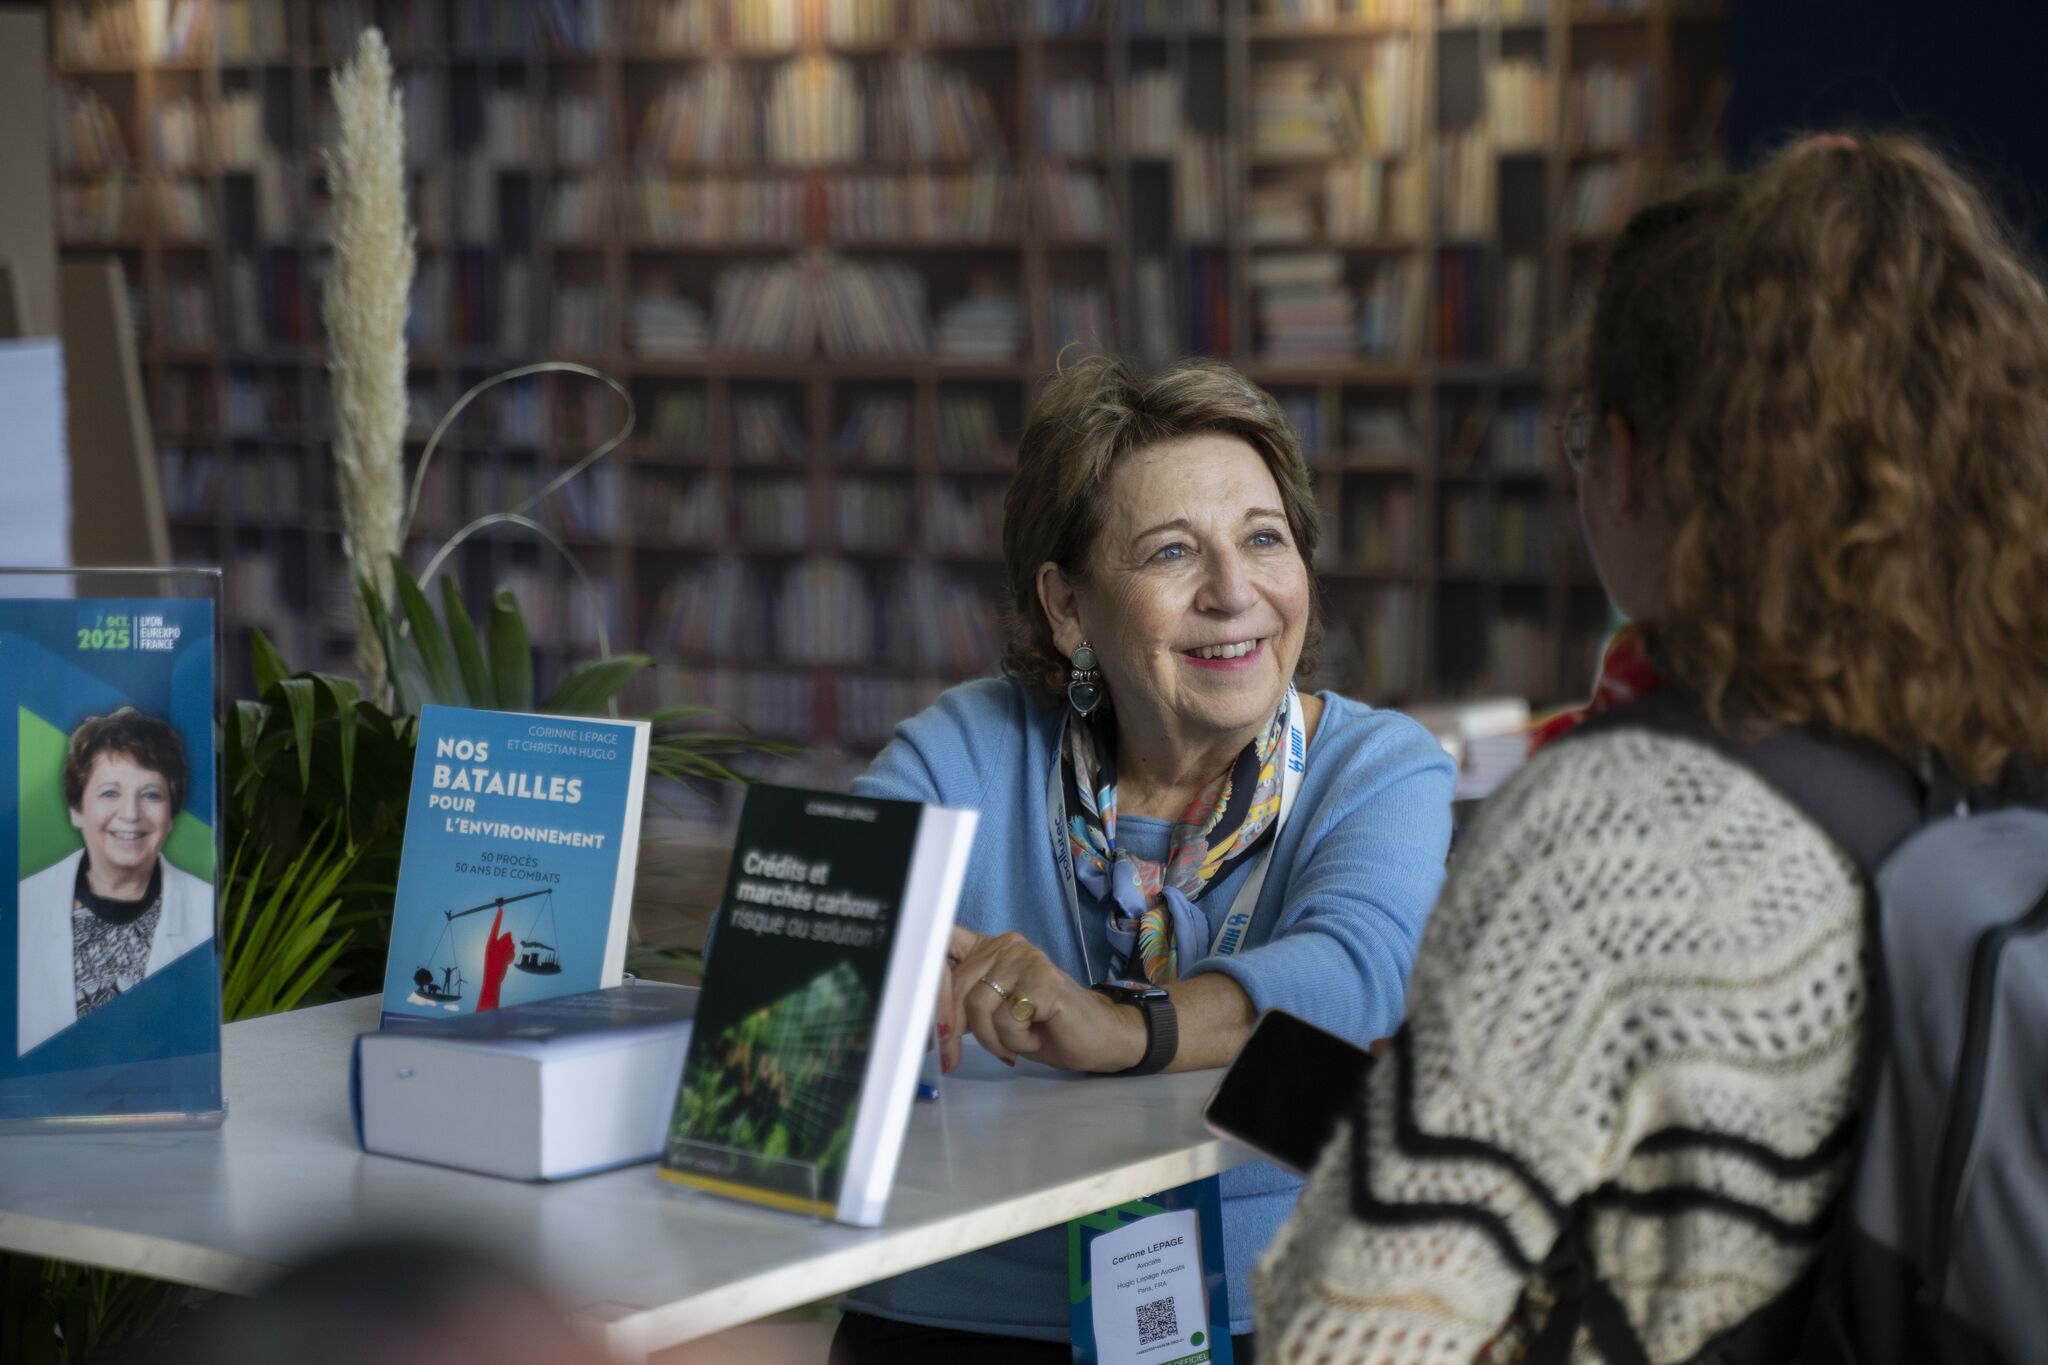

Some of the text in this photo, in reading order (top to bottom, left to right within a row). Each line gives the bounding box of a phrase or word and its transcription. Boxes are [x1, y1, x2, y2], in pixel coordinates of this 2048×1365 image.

[141, 615, 164, 627] LYON
[77, 628, 130, 649] 2025
[141, 627, 181, 638] EUREXPO
[141, 638, 175, 650] FRANCE
[528, 726, 618, 745] CORINNE LEPAGE
[436, 737, 489, 762] NOS
[507, 739, 617, 761] ET CHRISTIAN HUGLO
[432, 764, 583, 804] BATAILLES
[428, 794, 476, 813] POUR
[480, 851, 538, 868] 50 PROCÈS
[1054, 816, 1072, 881] pollutec
[455, 862, 560, 884] 50 ANS DE COMBATS
[743, 852, 830, 886] Crédits et
[736, 882, 813, 911] marchés
[814, 892, 880, 920] carbone
[730, 908, 785, 936] risque
[786, 916, 810, 939] ou
[809, 919, 873, 947] solution
[1216, 928, 1241, 955] HUO
[1112, 1236, 1184, 1266] Corinne LEPAGE
[1136, 1258, 1161, 1270] Avocate
[1117, 1264, 1185, 1290] Huglo Lepage Avocats
[1137, 1280, 1167, 1295] Paris, FRA
[1174, 1353, 1209, 1365] OFFICIEL
